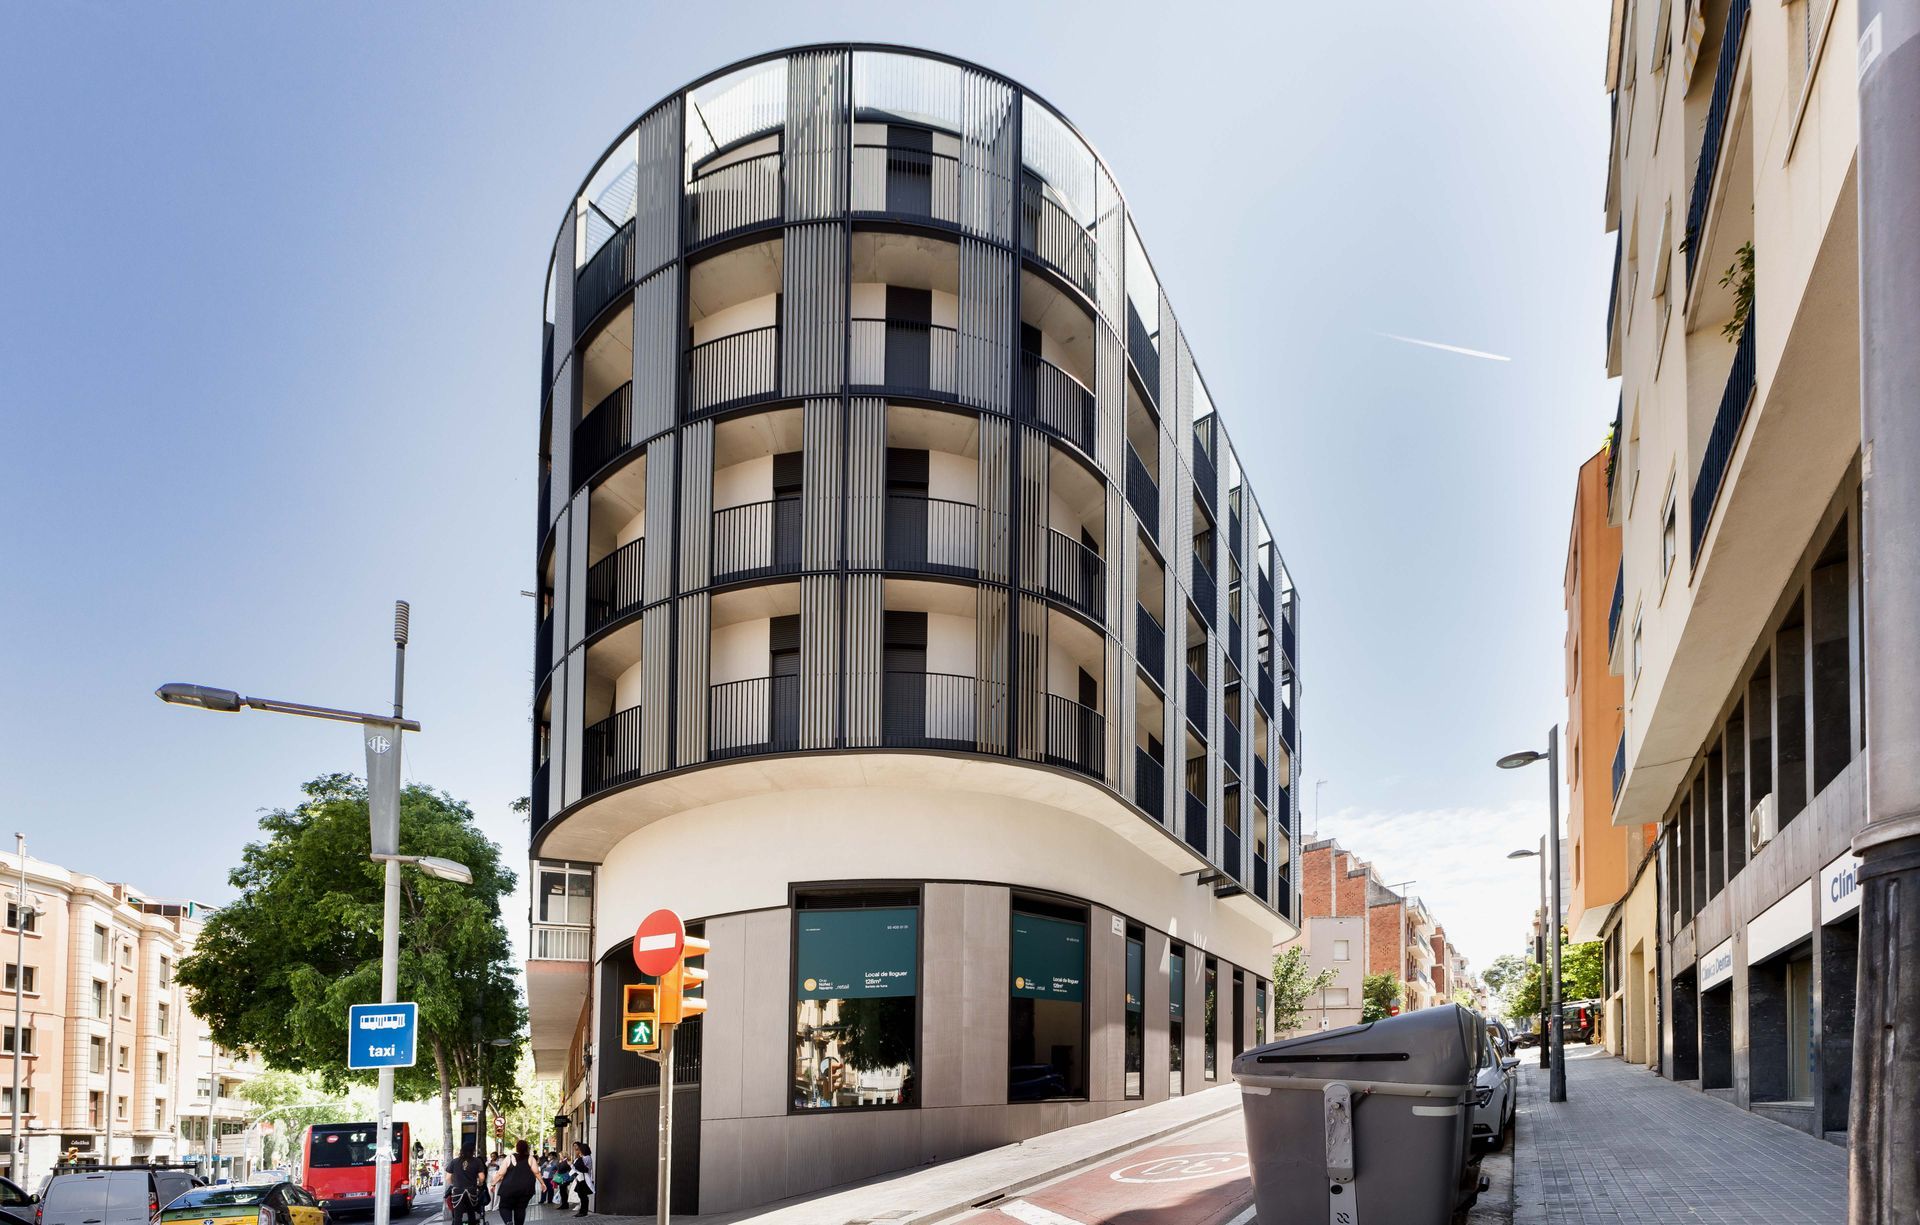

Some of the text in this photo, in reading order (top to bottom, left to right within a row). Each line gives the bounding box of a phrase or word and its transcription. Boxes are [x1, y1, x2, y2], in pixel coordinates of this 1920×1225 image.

[1831, 863, 1857, 903] Clíni
[368, 1043, 396, 1058] taxi
[350, 1132, 367, 1142] 47
